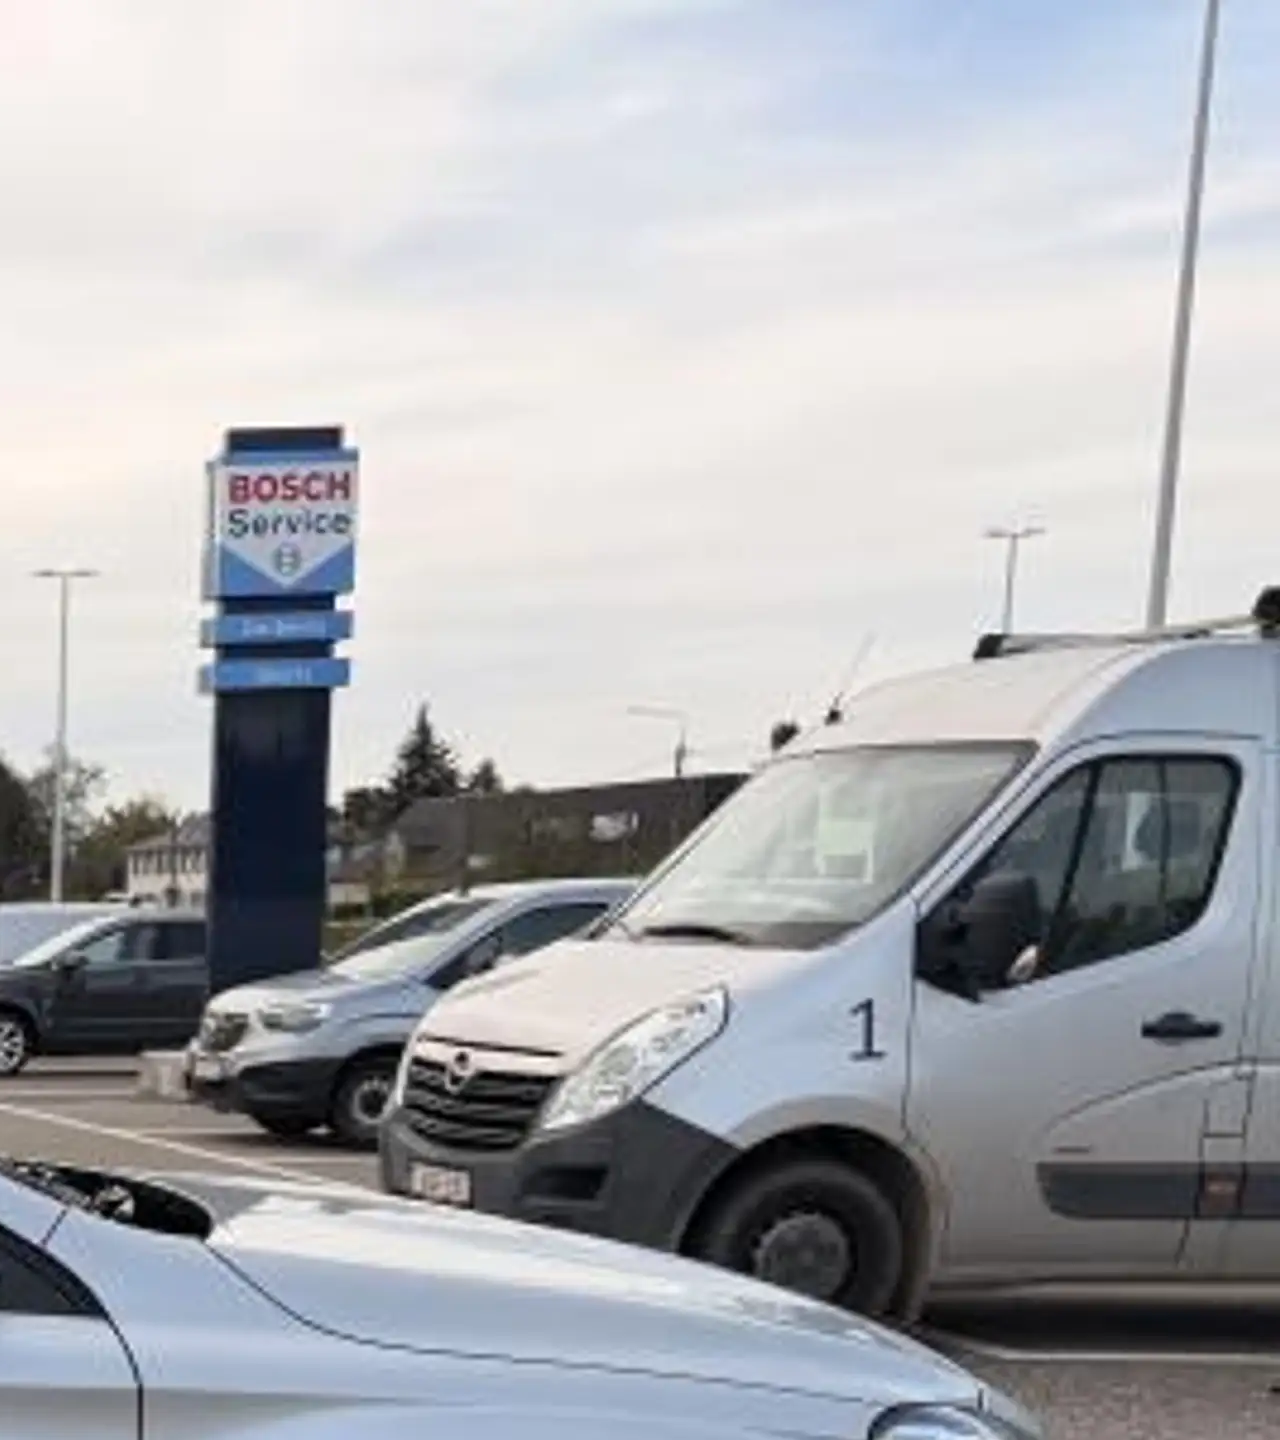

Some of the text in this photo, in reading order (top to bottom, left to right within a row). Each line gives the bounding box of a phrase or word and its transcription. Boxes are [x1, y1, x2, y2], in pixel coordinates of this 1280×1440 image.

[228, 471, 351, 503] BOSCH
[227, 507, 352, 538] Service
[848, 997, 888, 1062] 1
